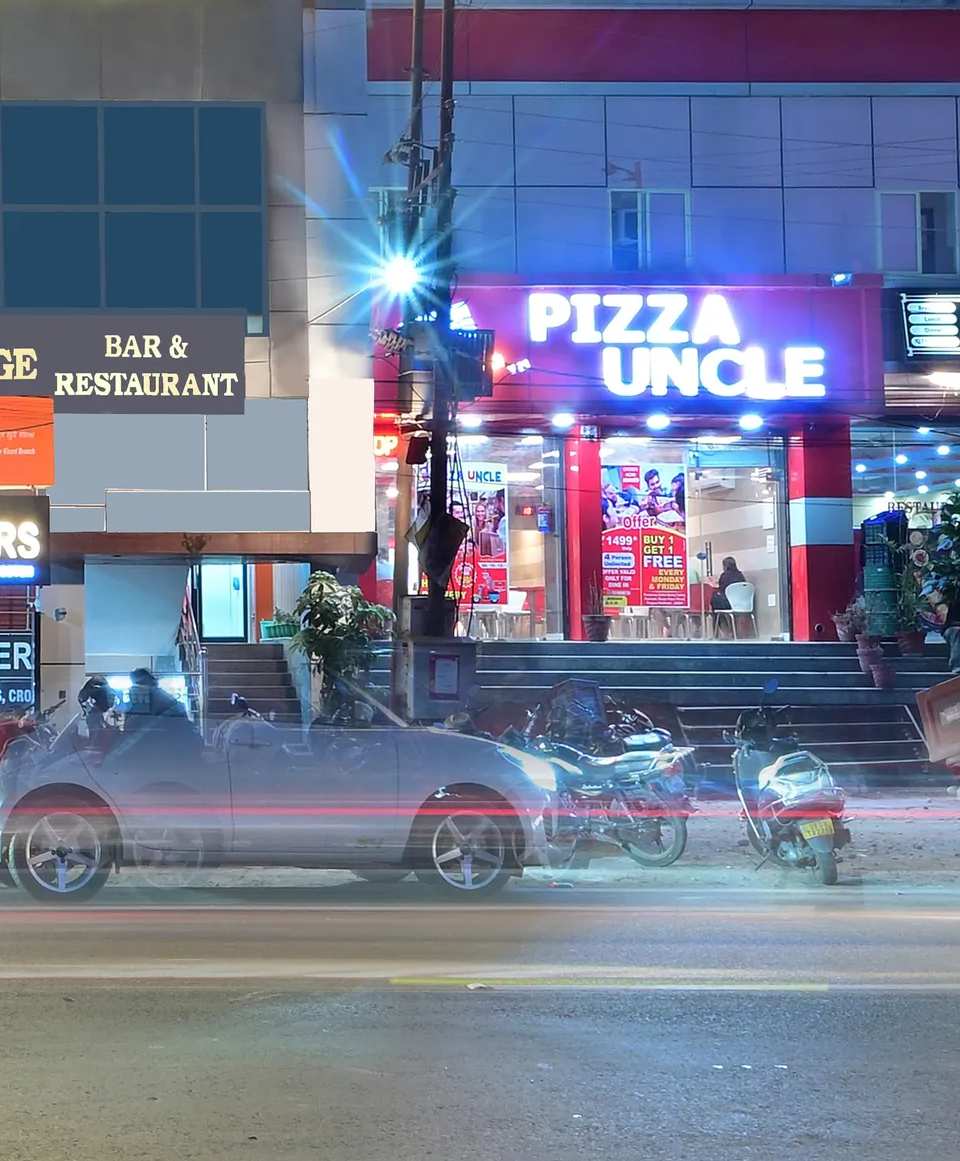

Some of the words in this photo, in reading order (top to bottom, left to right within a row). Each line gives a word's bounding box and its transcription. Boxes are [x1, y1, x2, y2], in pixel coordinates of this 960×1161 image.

[529, 292, 741, 345] PIZZA
[104, 334, 162, 358] BAR
[169, 334, 188, 359] &
[602, 346, 826, 400] UNCLE
[54, 372, 238, 396] RESTAURANT
[468, 470, 502, 483] UNCLE
[623, 516, 656, 529] Offer
[643, 535, 666, 544] BUY
[668, 535, 674, 544] 1
[643, 545, 665, 554] GET
[668, 546, 674, 554] 1
[643, 555, 684, 568] FREE
